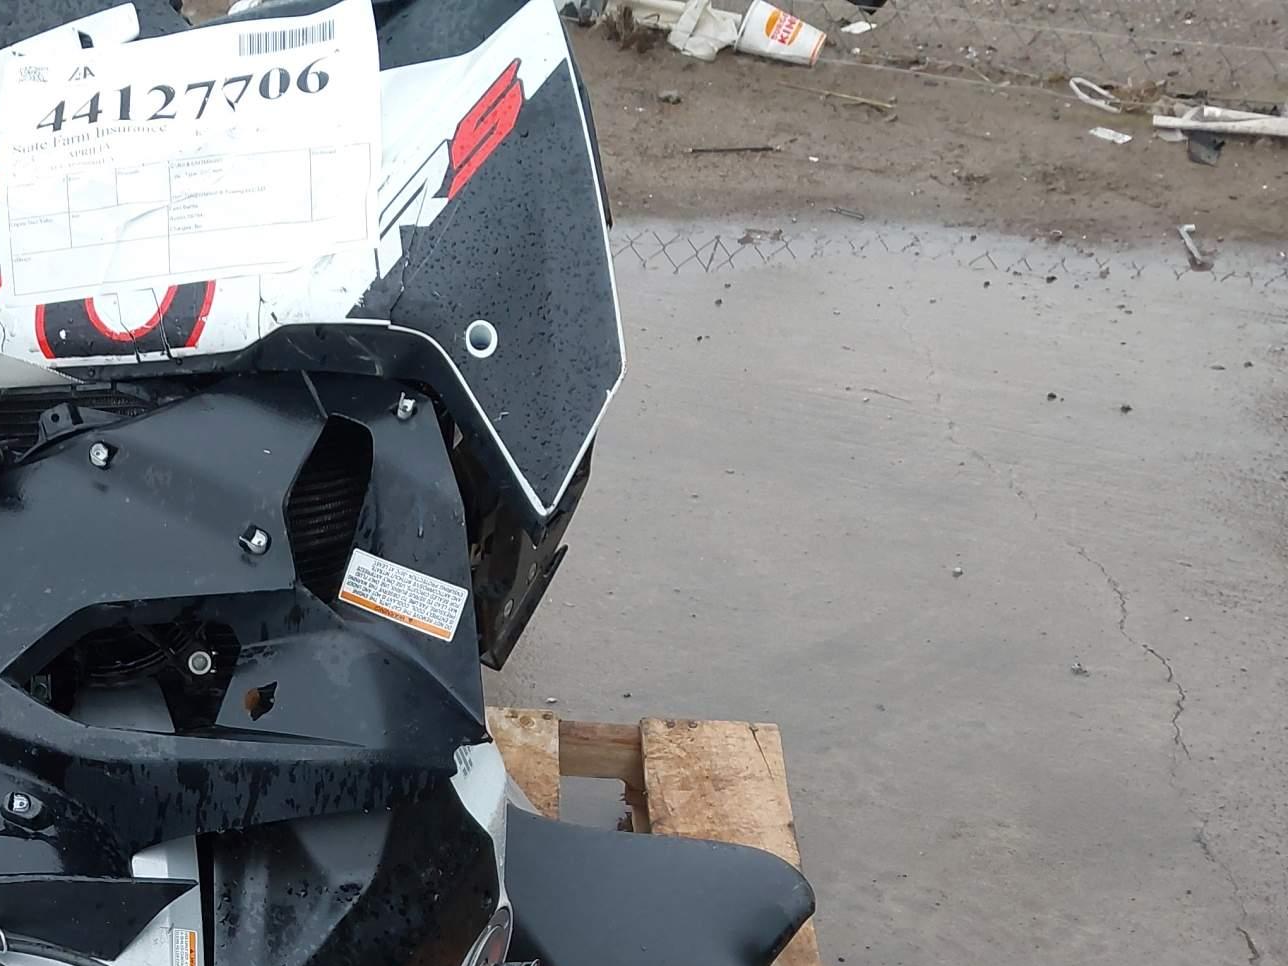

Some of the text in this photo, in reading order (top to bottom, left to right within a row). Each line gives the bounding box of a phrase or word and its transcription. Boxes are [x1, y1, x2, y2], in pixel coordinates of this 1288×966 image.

[36, 56, 331, 132] 44127706
[12, 124, 168, 153] State Farm Insurance
